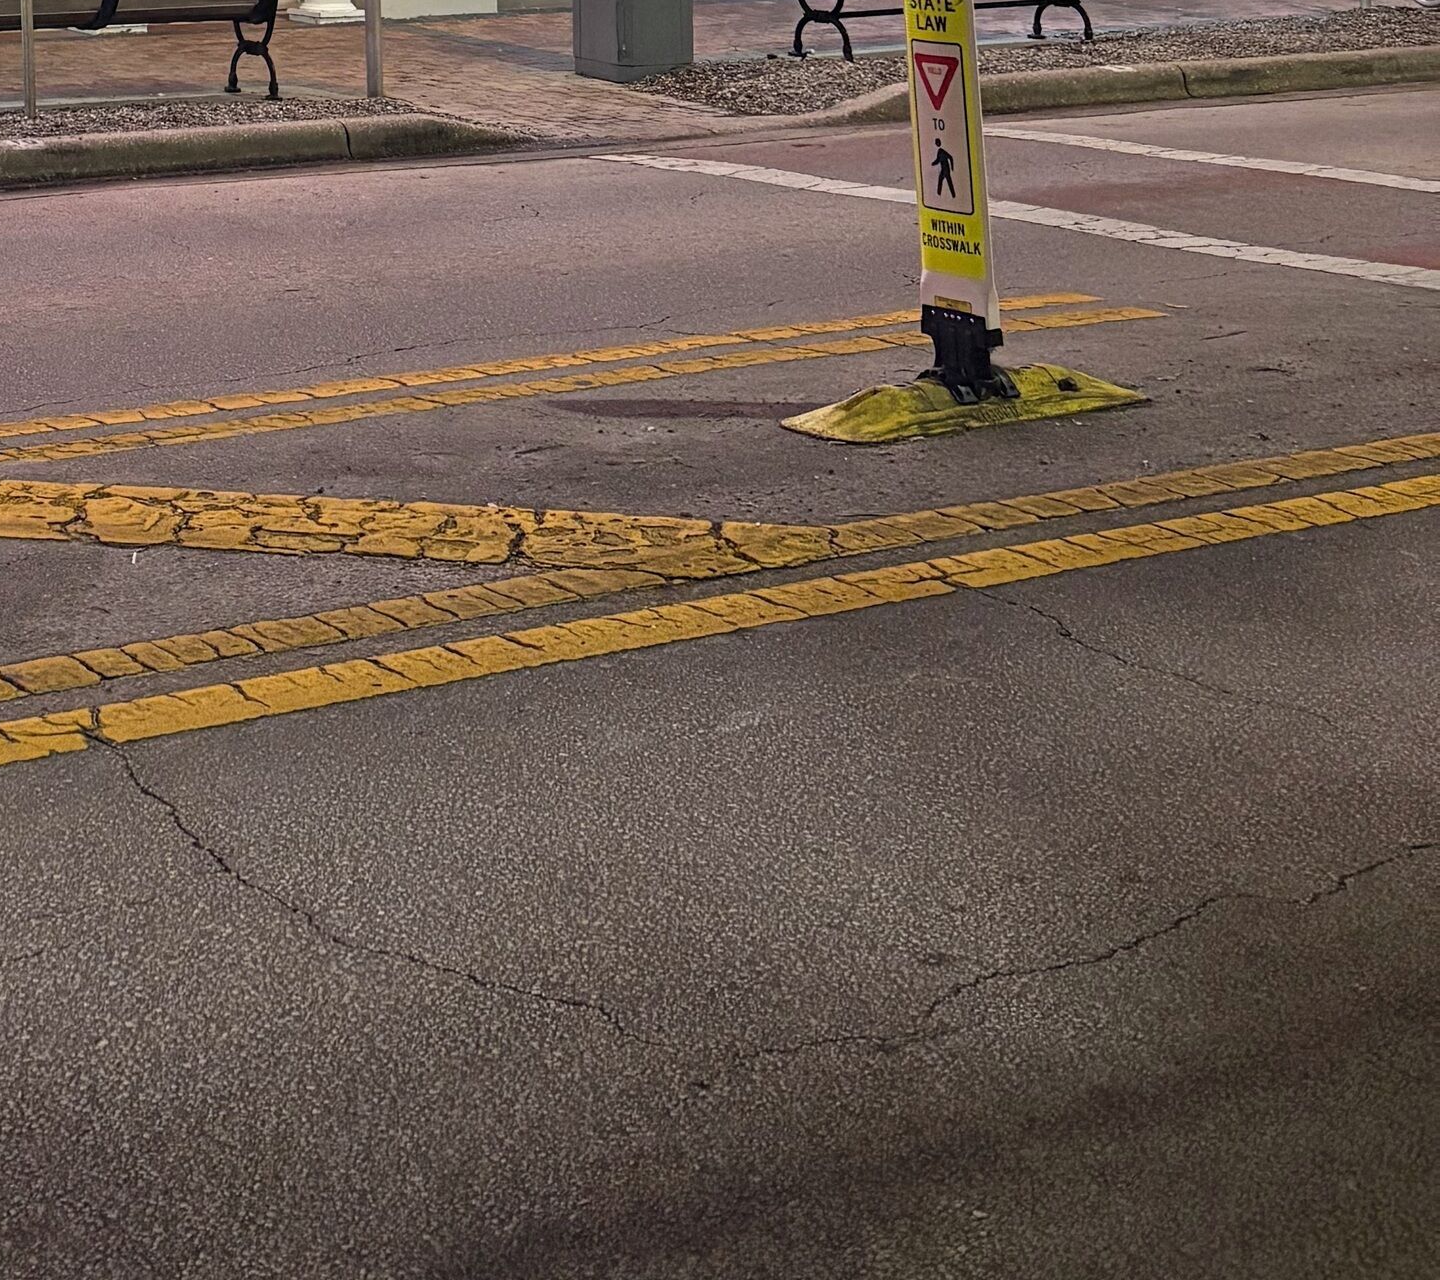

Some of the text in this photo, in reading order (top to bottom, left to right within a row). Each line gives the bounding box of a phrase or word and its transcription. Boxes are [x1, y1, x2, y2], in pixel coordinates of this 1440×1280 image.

[916, 13, 948, 33] LAW
[932, 117, 945, 132] TO
[931, 217, 966, 236] WITHIN
[922, 231, 982, 256] CROSSWALK
